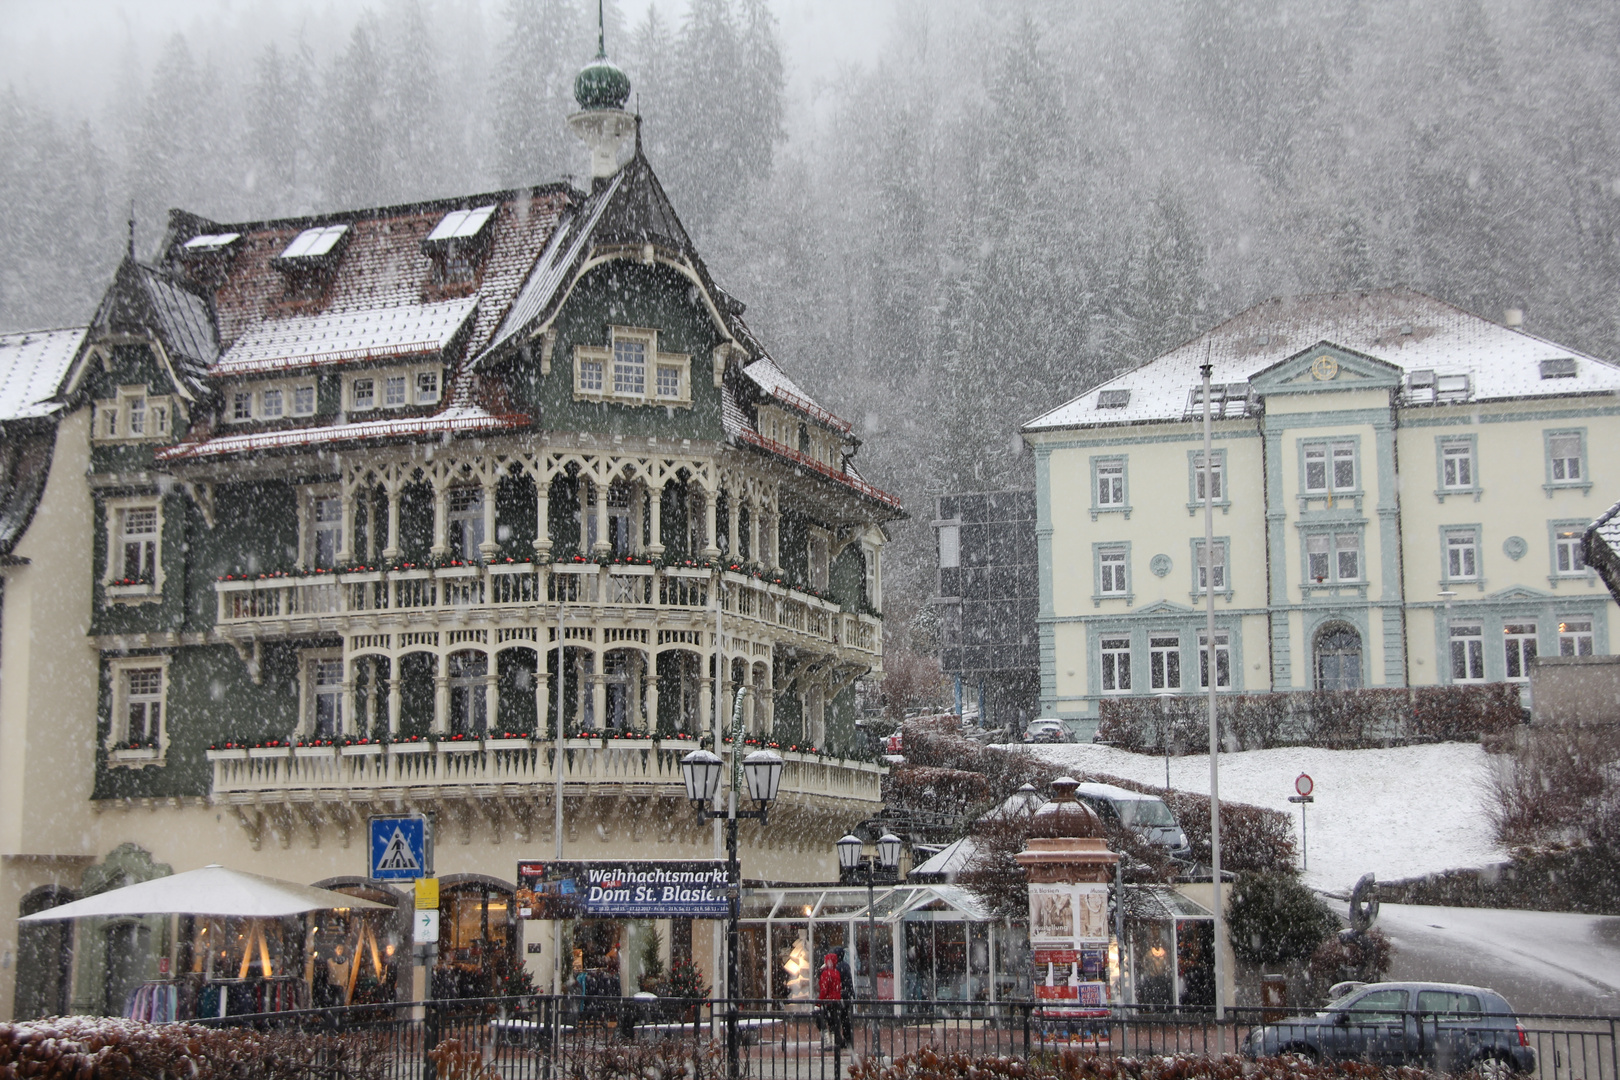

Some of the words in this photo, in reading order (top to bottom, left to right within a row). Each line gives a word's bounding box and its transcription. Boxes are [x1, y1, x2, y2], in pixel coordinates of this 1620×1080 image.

[588, 868, 729, 883] Weihnachtsmarkt
[588, 886, 630, 902] Dom
[635, 886, 657, 902] St.
